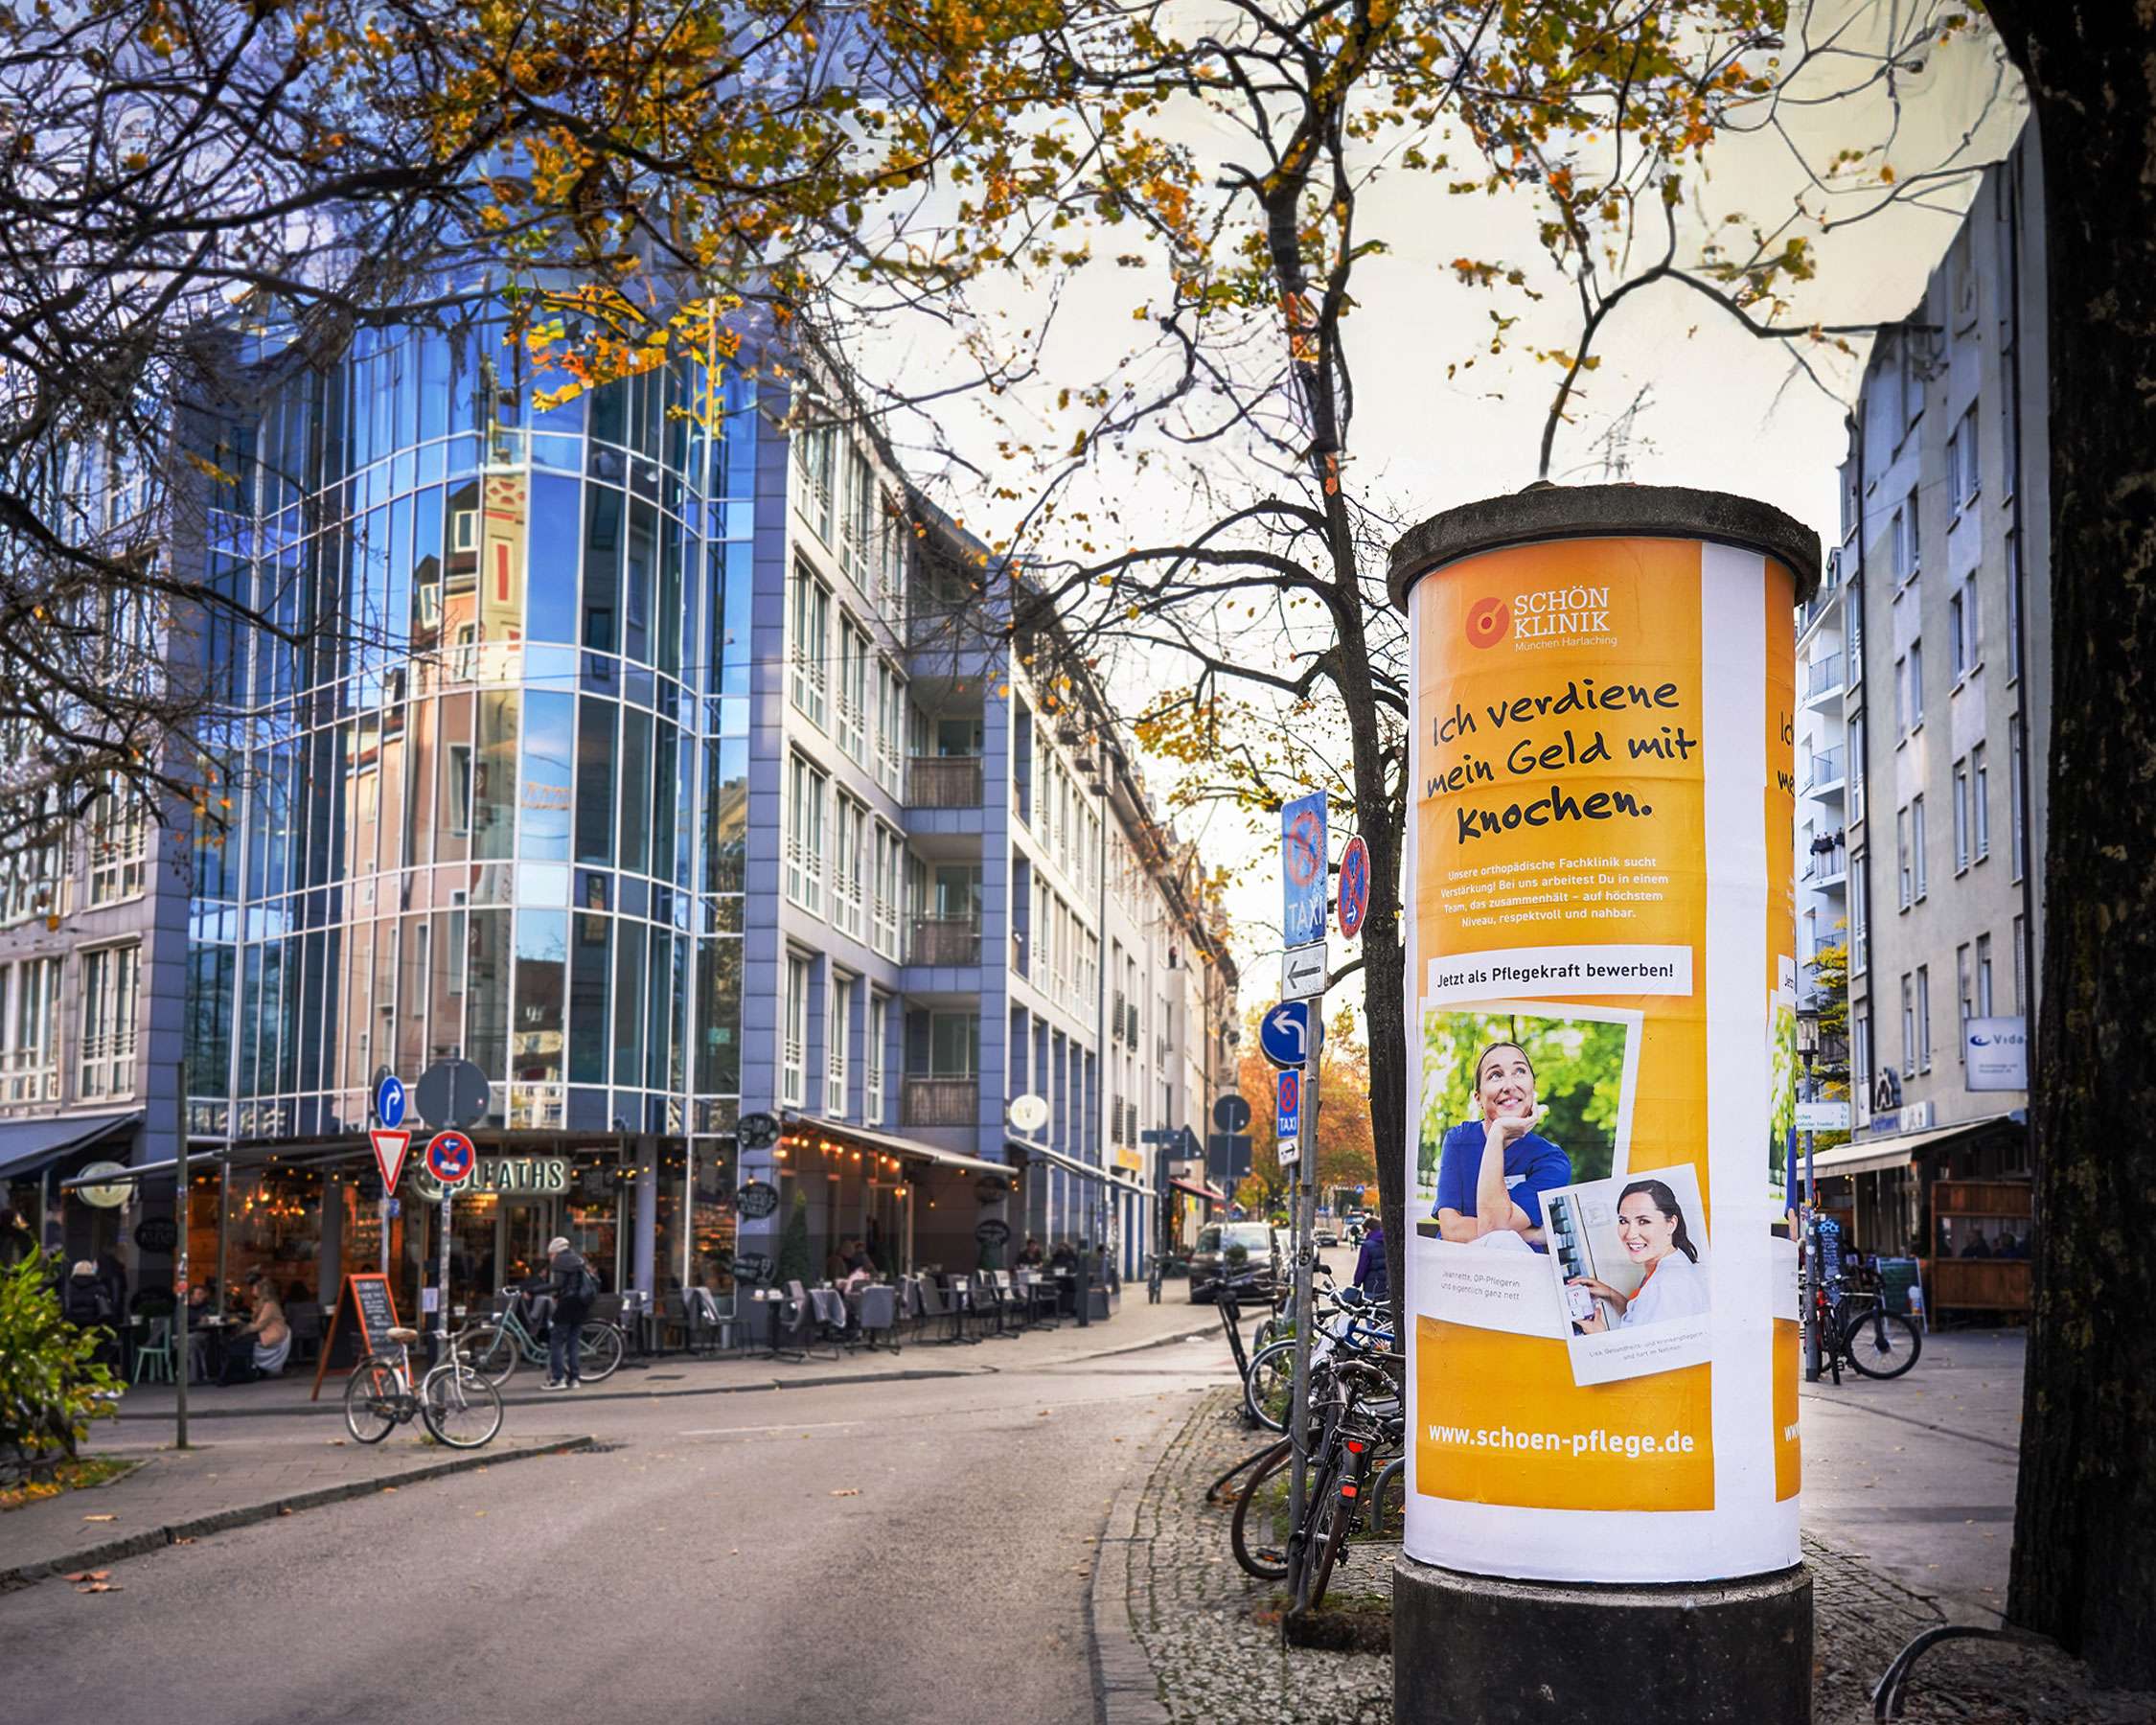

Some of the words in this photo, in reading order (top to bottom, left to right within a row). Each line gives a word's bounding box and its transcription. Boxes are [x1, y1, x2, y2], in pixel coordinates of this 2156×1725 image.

[1514, 586, 1610, 615] SCHÖN
[1514, 611, 1610, 639] KLINIK
[1562, 635, 1617, 648] Harlaching
[1434, 704, 1477, 747] Ich
[1487, 678, 1679, 728] verdiene
[1427, 754, 1494, 798] mein
[1507, 730, 1612, 774] Geld
[1628, 726, 1697, 759] mit
[1448, 866, 1478, 882] Unsere
[1480, 859, 1555, 876] orthopädische
[1559, 857, 1619, 869] Fachklinik
[1624, 857, 1657, 867] sucht
[1440, 883, 1496, 898] Verstärkung!
[1499, 880, 1515, 890] Bei
[1518, 879, 1538, 887] uns
[1541, 875, 1594, 887] arbeitest
[1598, 873, 1615, 884] Du
[1617, 873, 1630, 884] in
[1633, 874, 1668, 885] einem
[1288, 895, 1323, 932] TAXI
[1443, 904, 1467, 914] Team,
[1470, 899, 1486, 909] das
[1488, 892, 1569, 908] zusammenhält
[1583, 891, 1602, 902] auf
[1605, 890, 1663, 902] höchstem
[1461, 915, 1497, 928] Niveau,
[1499, 910, 1562, 925] respektvoll
[1565, 908, 1587, 920] und
[1591, 908, 1637, 919] nahbar.
[1436, 972, 1464, 988] Jetzt
[1468, 970, 1486, 984] als
[1492, 964, 1580, 984] Pflegekraft
[1587, 963, 1673, 978] bewerben!
[1279, 1116, 1296, 1132] TAXI
[1429, 1424, 1694, 1459] www.schoen-pflege.de
